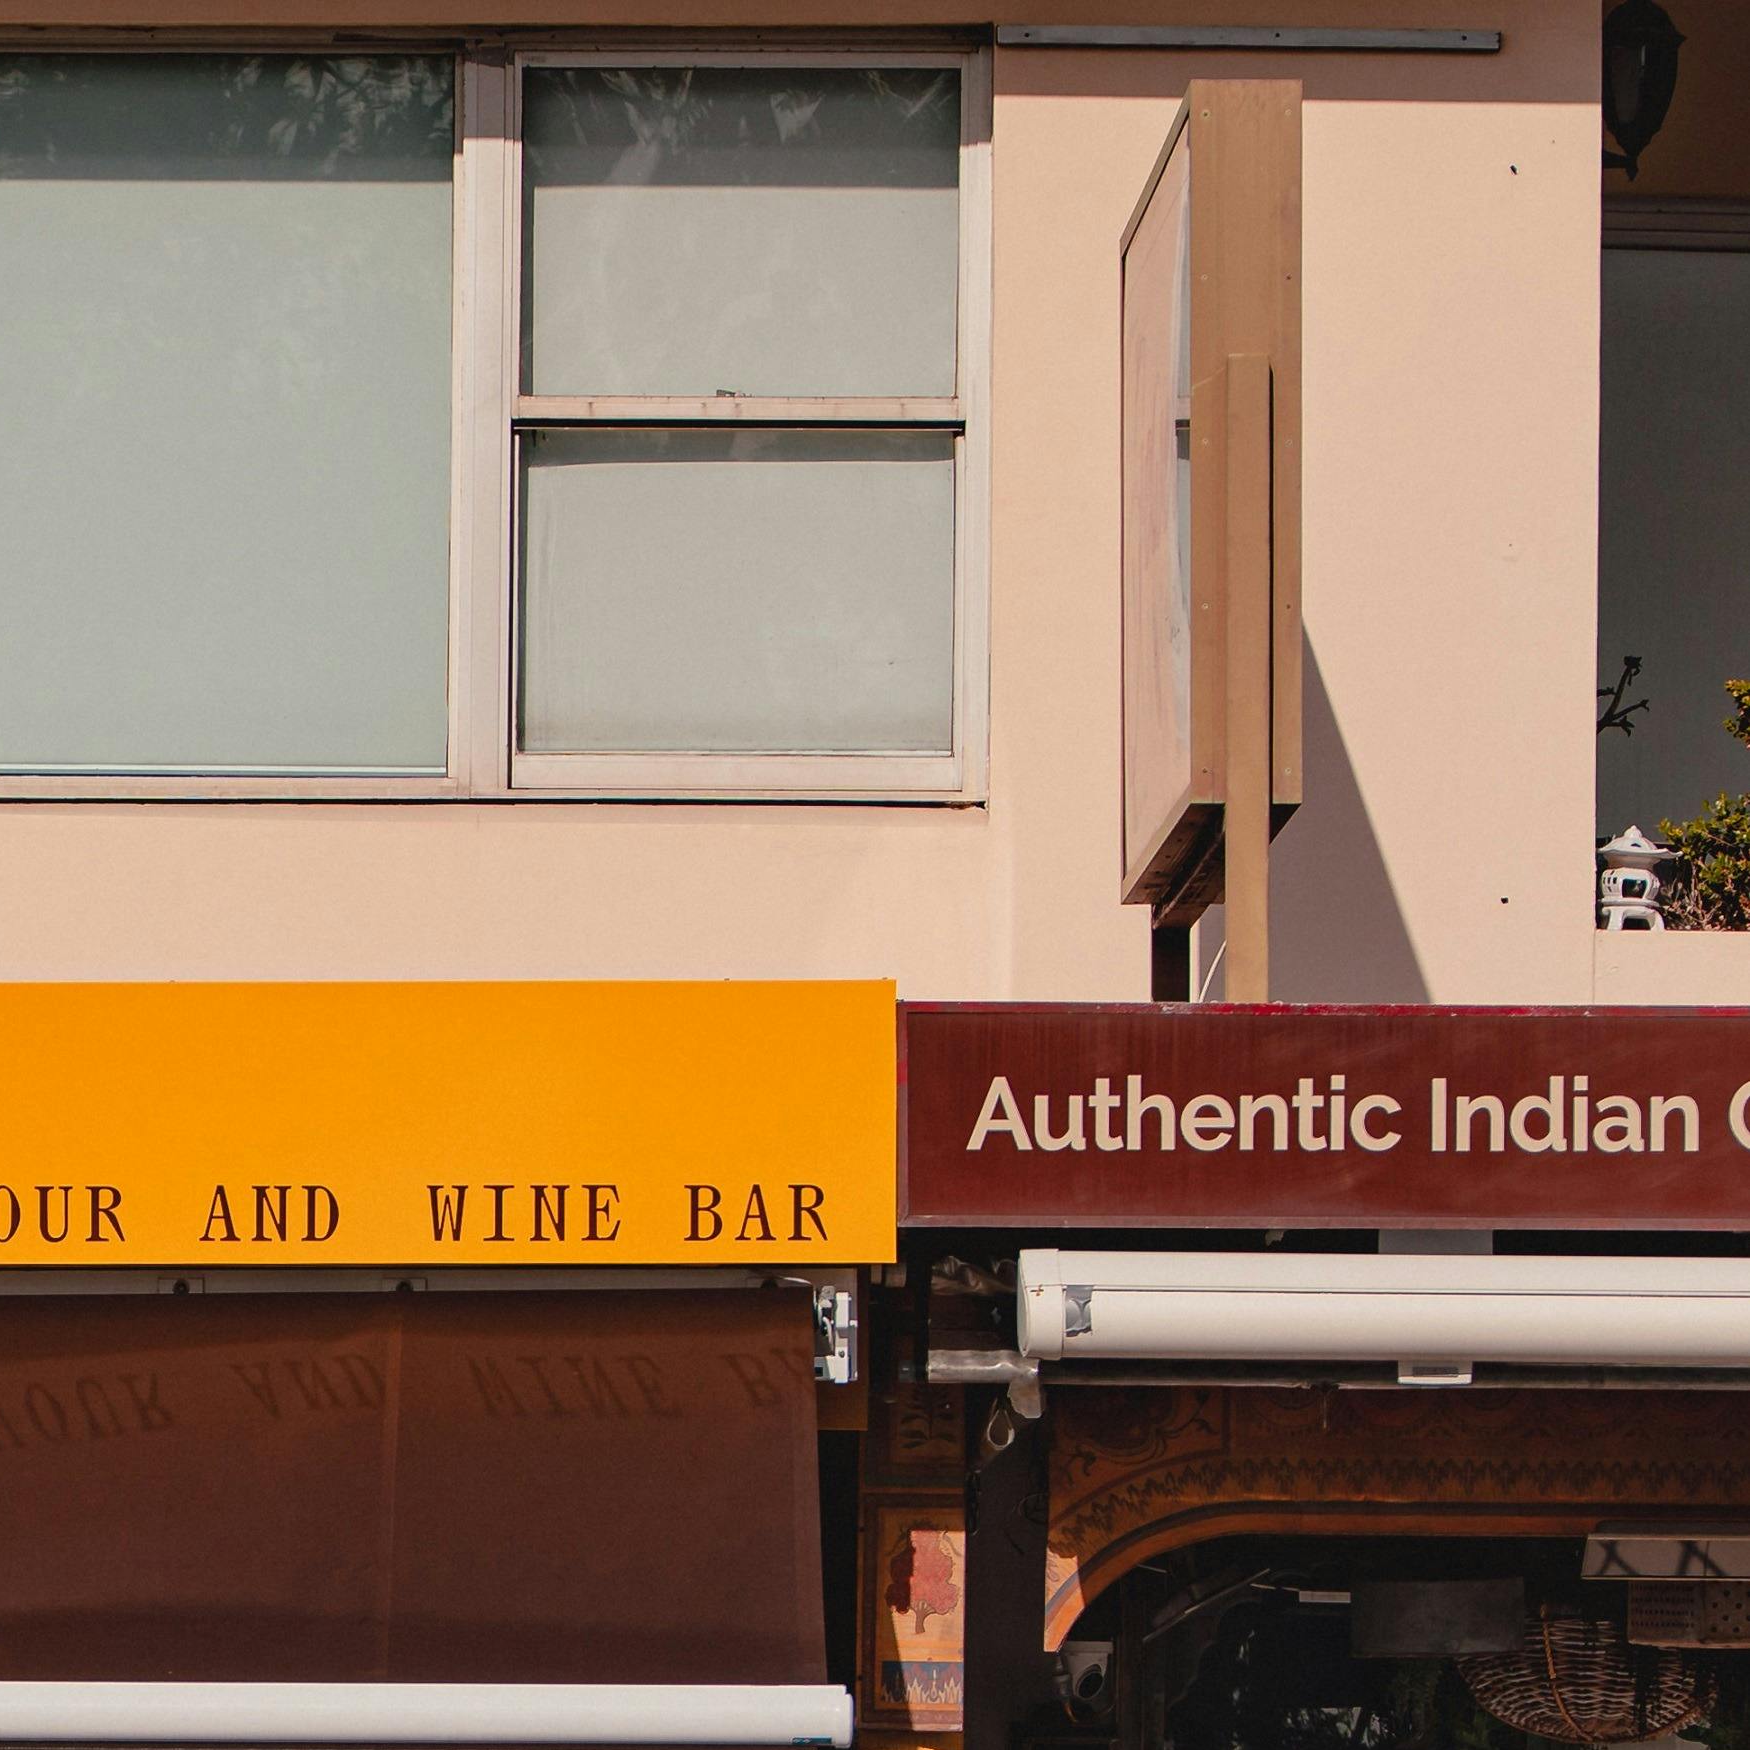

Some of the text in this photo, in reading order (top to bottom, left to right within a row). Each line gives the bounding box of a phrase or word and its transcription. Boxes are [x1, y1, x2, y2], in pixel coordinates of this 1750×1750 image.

[965, 1074, 1402, 1152] Authentic
[1431, 1075, 1700, 1153] Indian
[199, 1184, 340, 1243] AND
[426, 1184, 621, 1243] WINE
[683, 1184, 828, 1243] BAR
